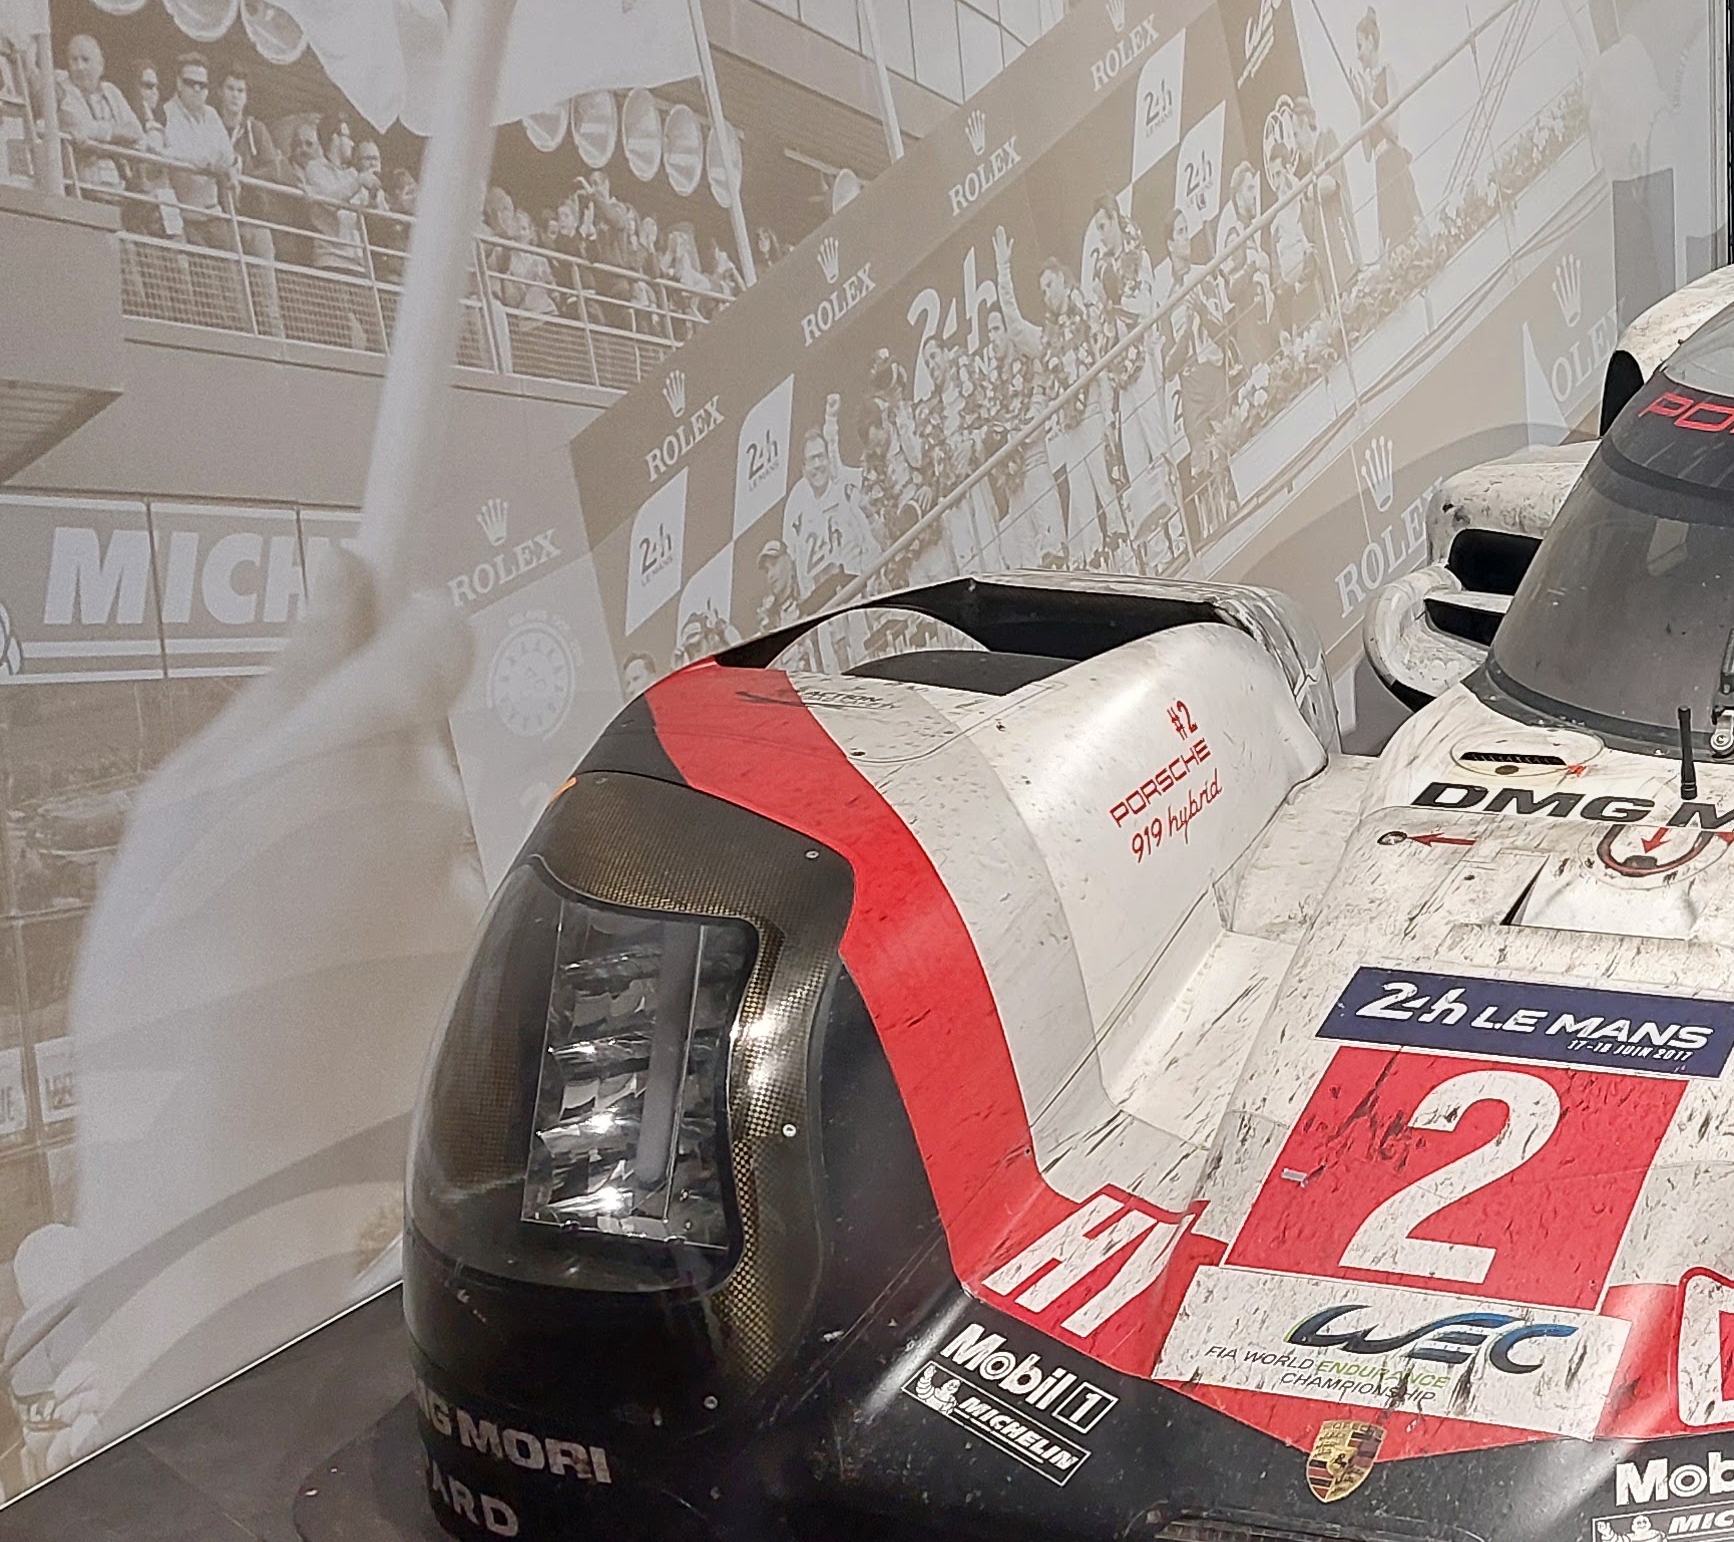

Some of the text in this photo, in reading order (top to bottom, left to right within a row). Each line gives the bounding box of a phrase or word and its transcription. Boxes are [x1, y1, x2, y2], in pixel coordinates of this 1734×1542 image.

[1091, 13, 1160, 92] ROLEX
[948, 135, 1021, 217] ROLEX
[800, 262, 877, 348] ROLEX
[645, 395, 725, 482] ROLEX
[446, 528, 562, 608] ROLEX
[1167, 700, 1198, 740] #2
[1109, 737, 1211, 828] PORSCHE
[1132, 768, 1223, 863] 919 hybrid
[1408, 780, 1658, 824] DMG
[1471, 1005, 1548, 1033] LE
[1545, 1013, 1714, 1050] MANS
[1613, 1043, 1651, 1057] JUIN
[1651, 1047, 1694, 1061] 2017
[1339, 1069, 1561, 1285] 2
[940, 1322, 1077, 1410] Mobil
[1204, 1345, 1450, 1388] FIA WORLD ENDURANCE
[1283, 1304, 1579, 1373] WEC
[1280, 1373, 1436, 1402] CHAMPIONSHIP
[456, 1408, 612, 1484] MORI
[959, 1396, 1079, 1471] MICHELIN
